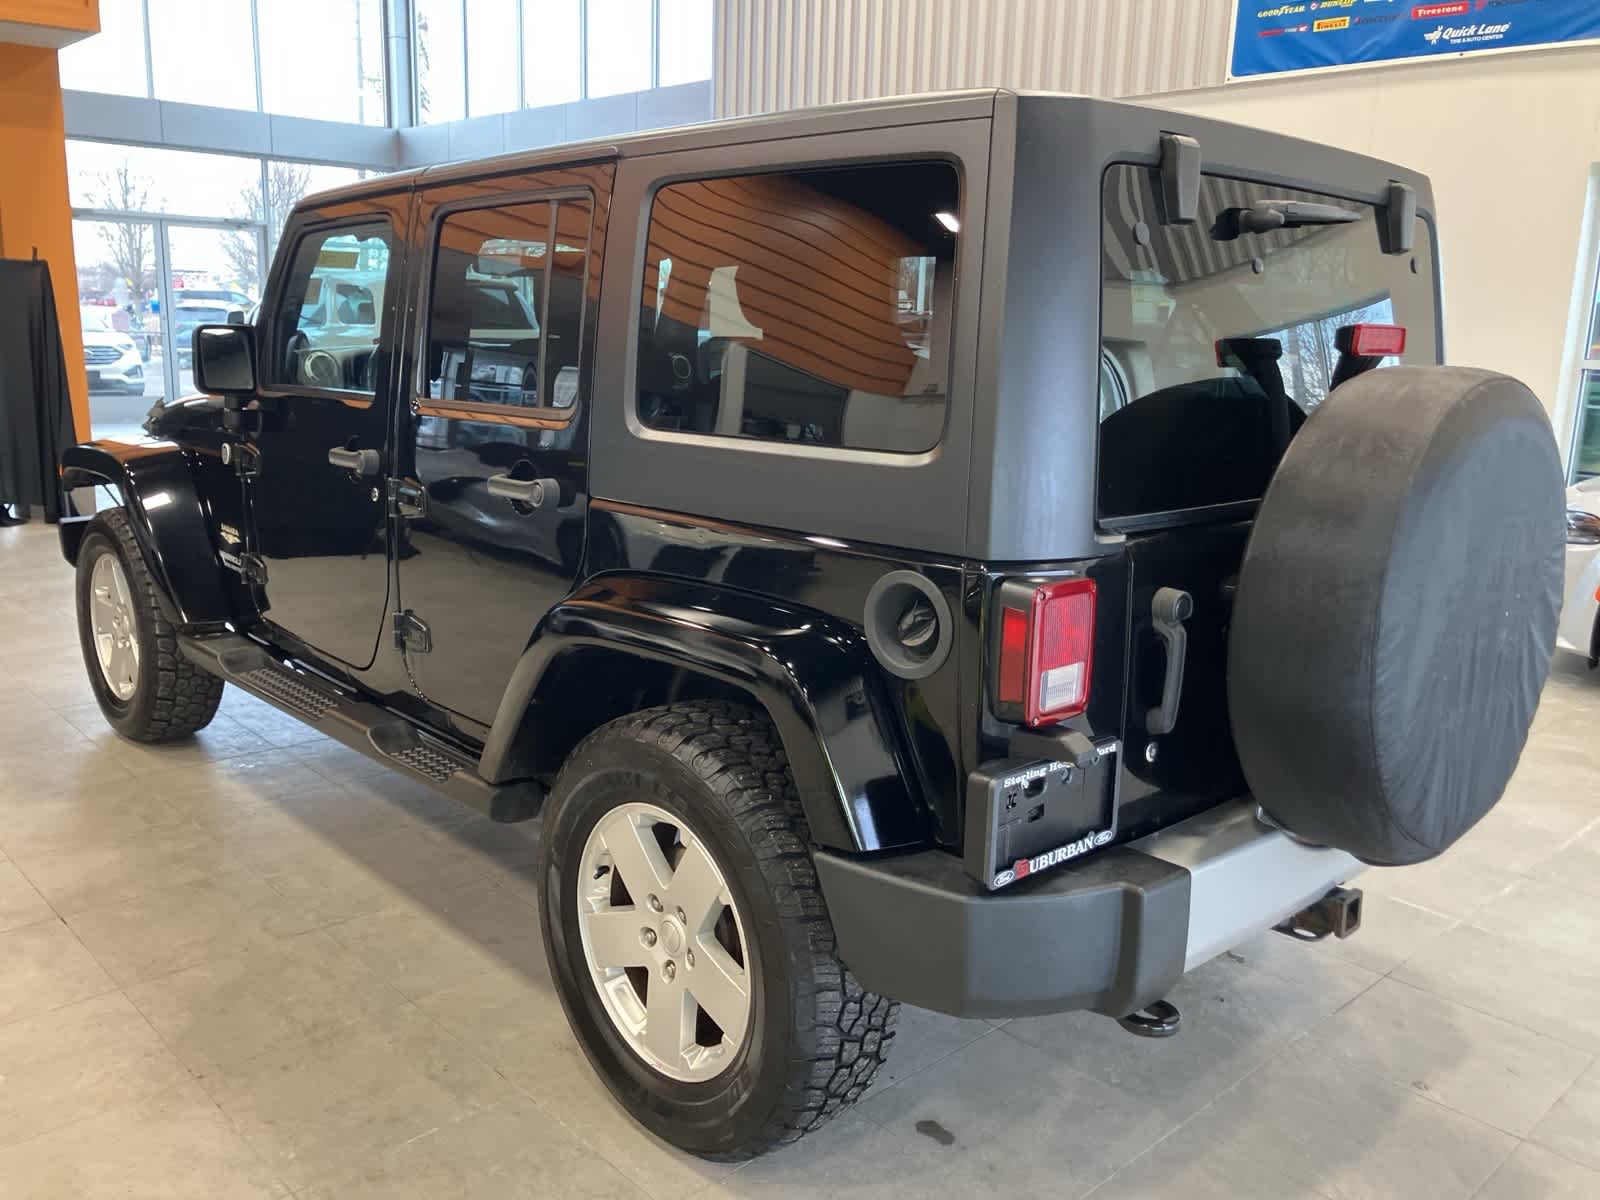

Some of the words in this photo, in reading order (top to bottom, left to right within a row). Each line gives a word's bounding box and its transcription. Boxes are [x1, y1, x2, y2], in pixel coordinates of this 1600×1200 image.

[1257, 5, 1305, 18] GOODYEAR
[1417, 5, 1464, 17] Firestone
[1442, 25, 1477, 40] Quick
[1477, 23, 1510, 35] Lane
[1003, 767, 1047, 788] Sterling
[1014, 836, 1095, 879] SUBURBAN
